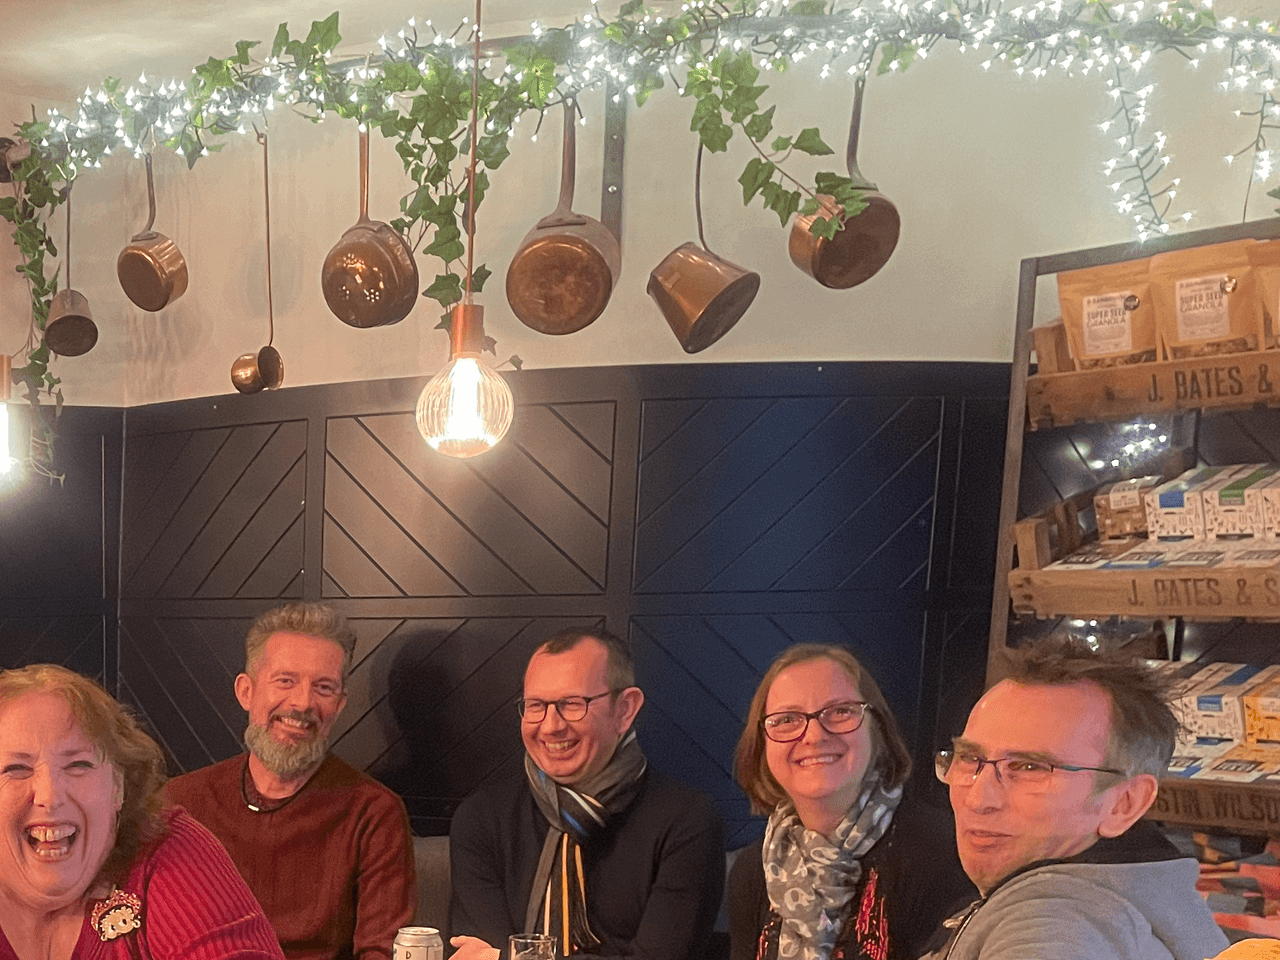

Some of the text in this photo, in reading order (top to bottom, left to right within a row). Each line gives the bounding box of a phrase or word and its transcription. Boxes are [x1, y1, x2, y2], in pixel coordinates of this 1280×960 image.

[1147, 363, 1274, 402] J. BATES &
[1127, 579, 1144, 607] J.
[1154, 577, 1222, 608] BATES
[1236, 578, 1252, 607] &
